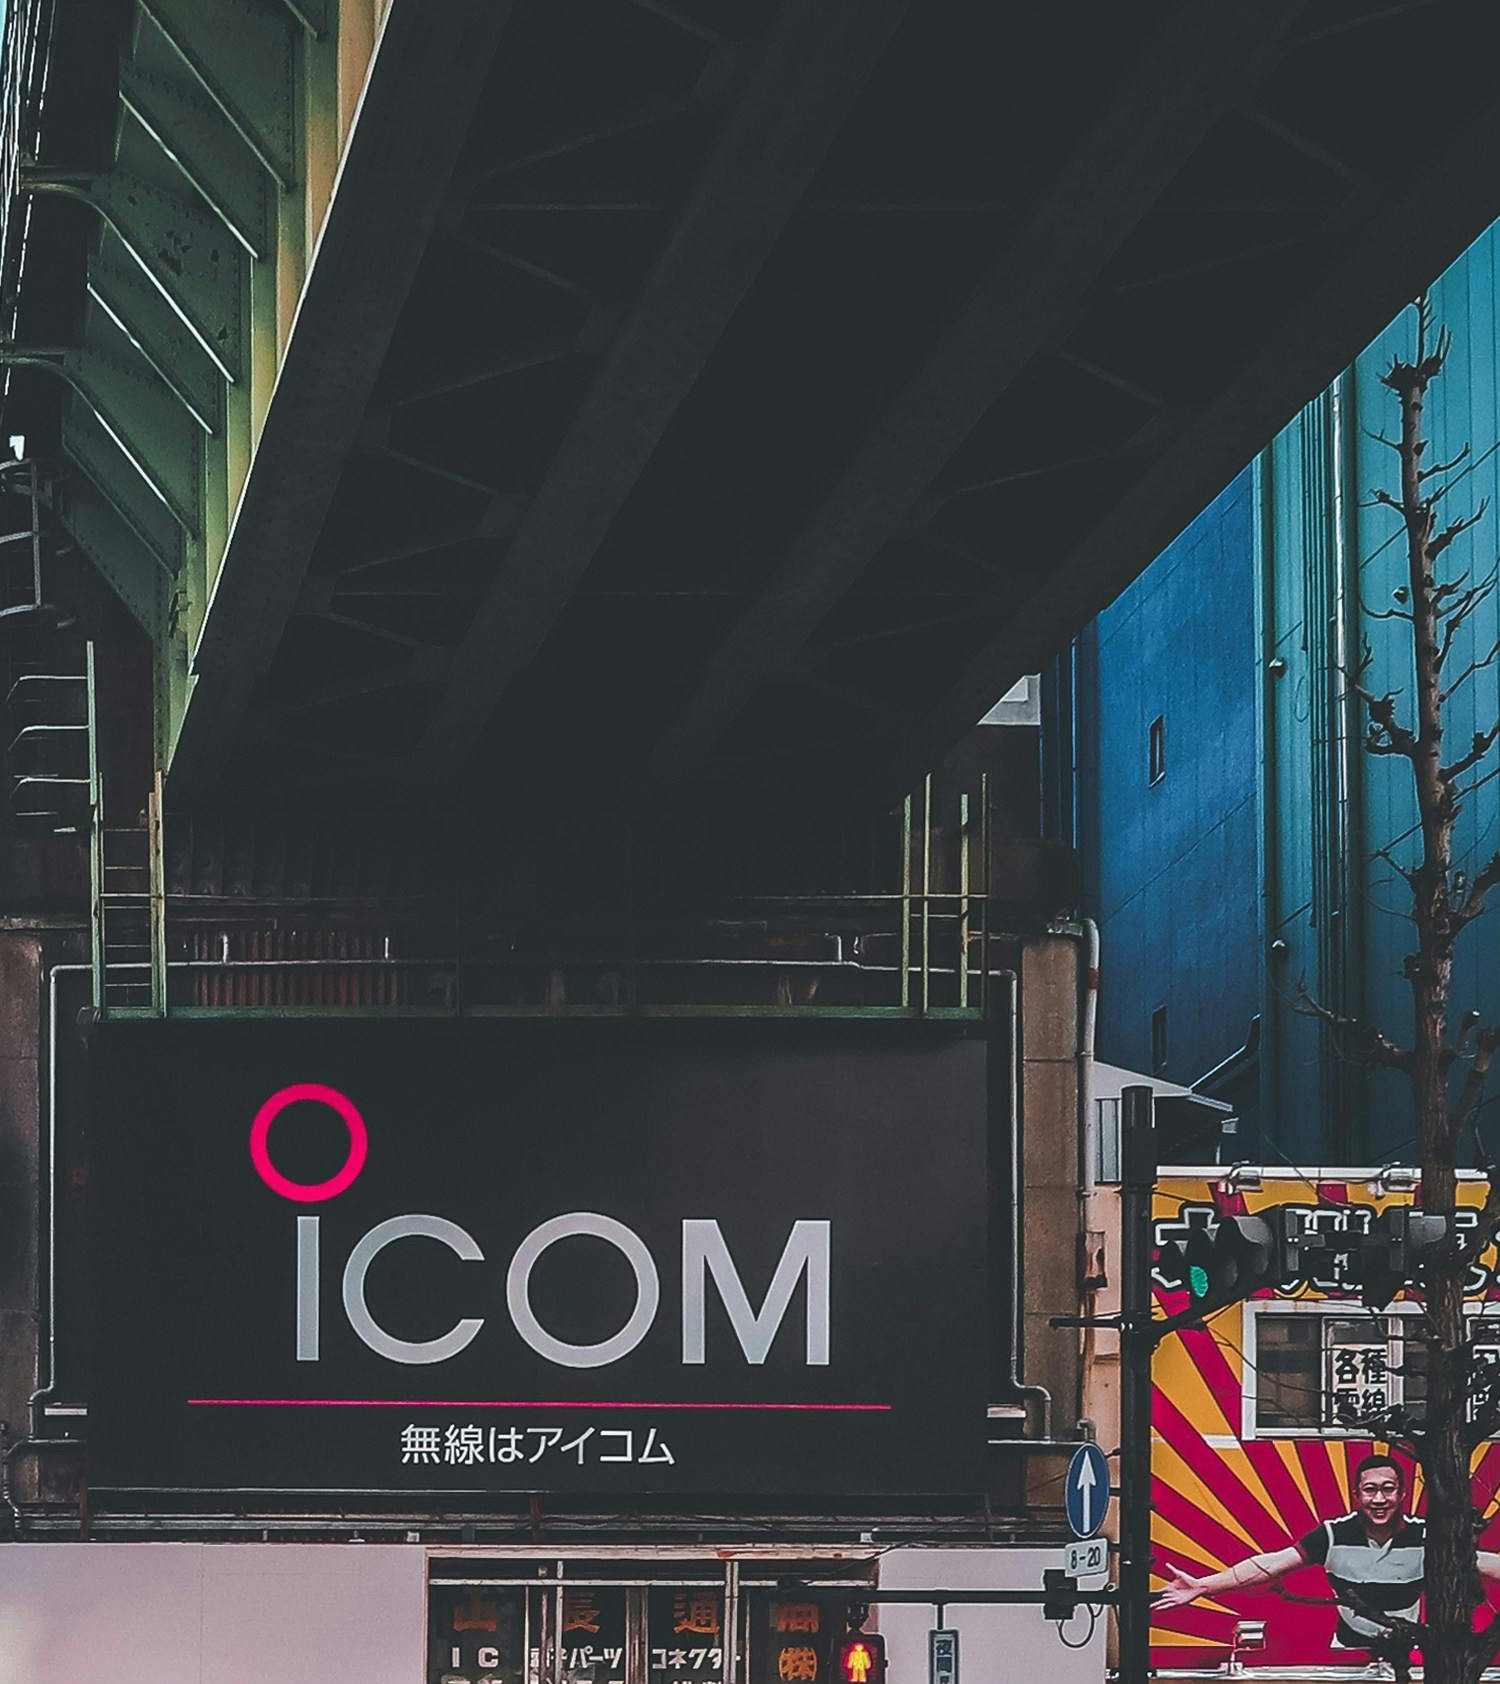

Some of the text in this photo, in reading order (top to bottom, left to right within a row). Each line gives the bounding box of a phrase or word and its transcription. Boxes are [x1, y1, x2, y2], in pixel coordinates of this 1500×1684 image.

[1334, 1348, 1388, 1387] 各種
[399, 1423, 677, 1467] 無線はアイコム
[1070, 1546, 1100, 1571] 8-20
